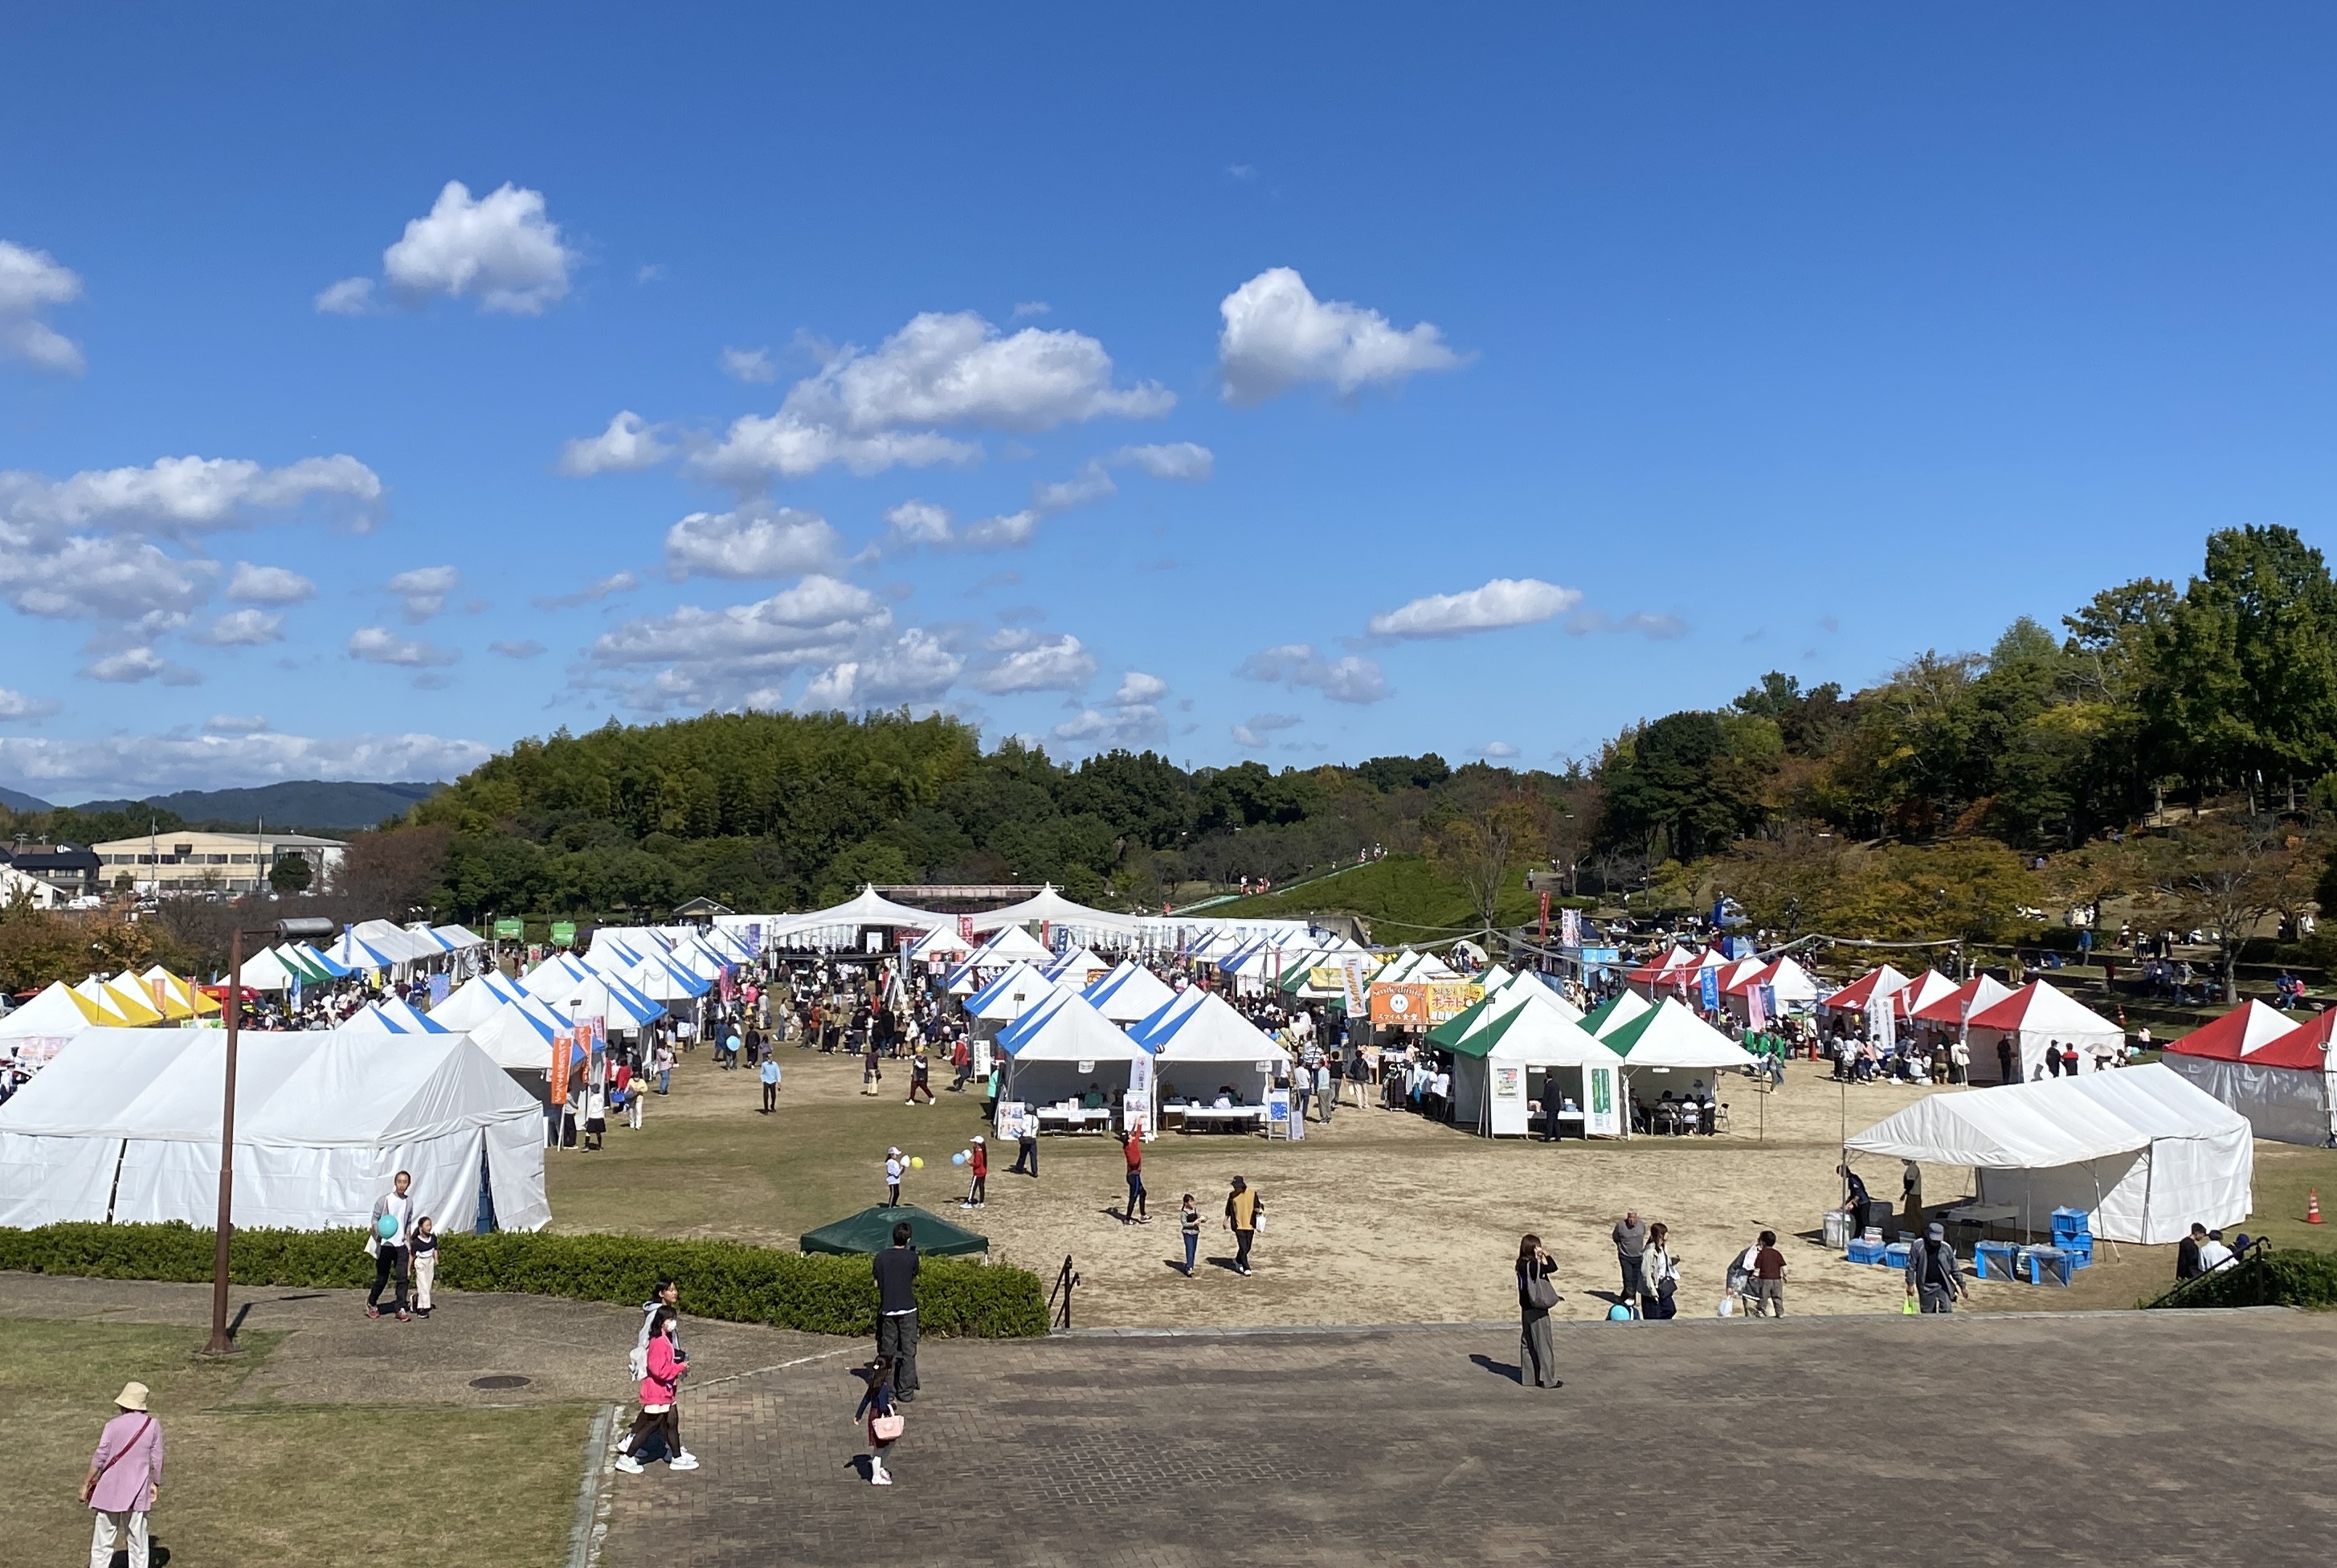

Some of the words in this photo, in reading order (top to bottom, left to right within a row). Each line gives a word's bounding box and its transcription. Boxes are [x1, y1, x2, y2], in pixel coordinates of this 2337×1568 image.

[1432, 996, 1463, 1007] ポテト
[1378, 1013, 1418, 1021] スマイル食堂
